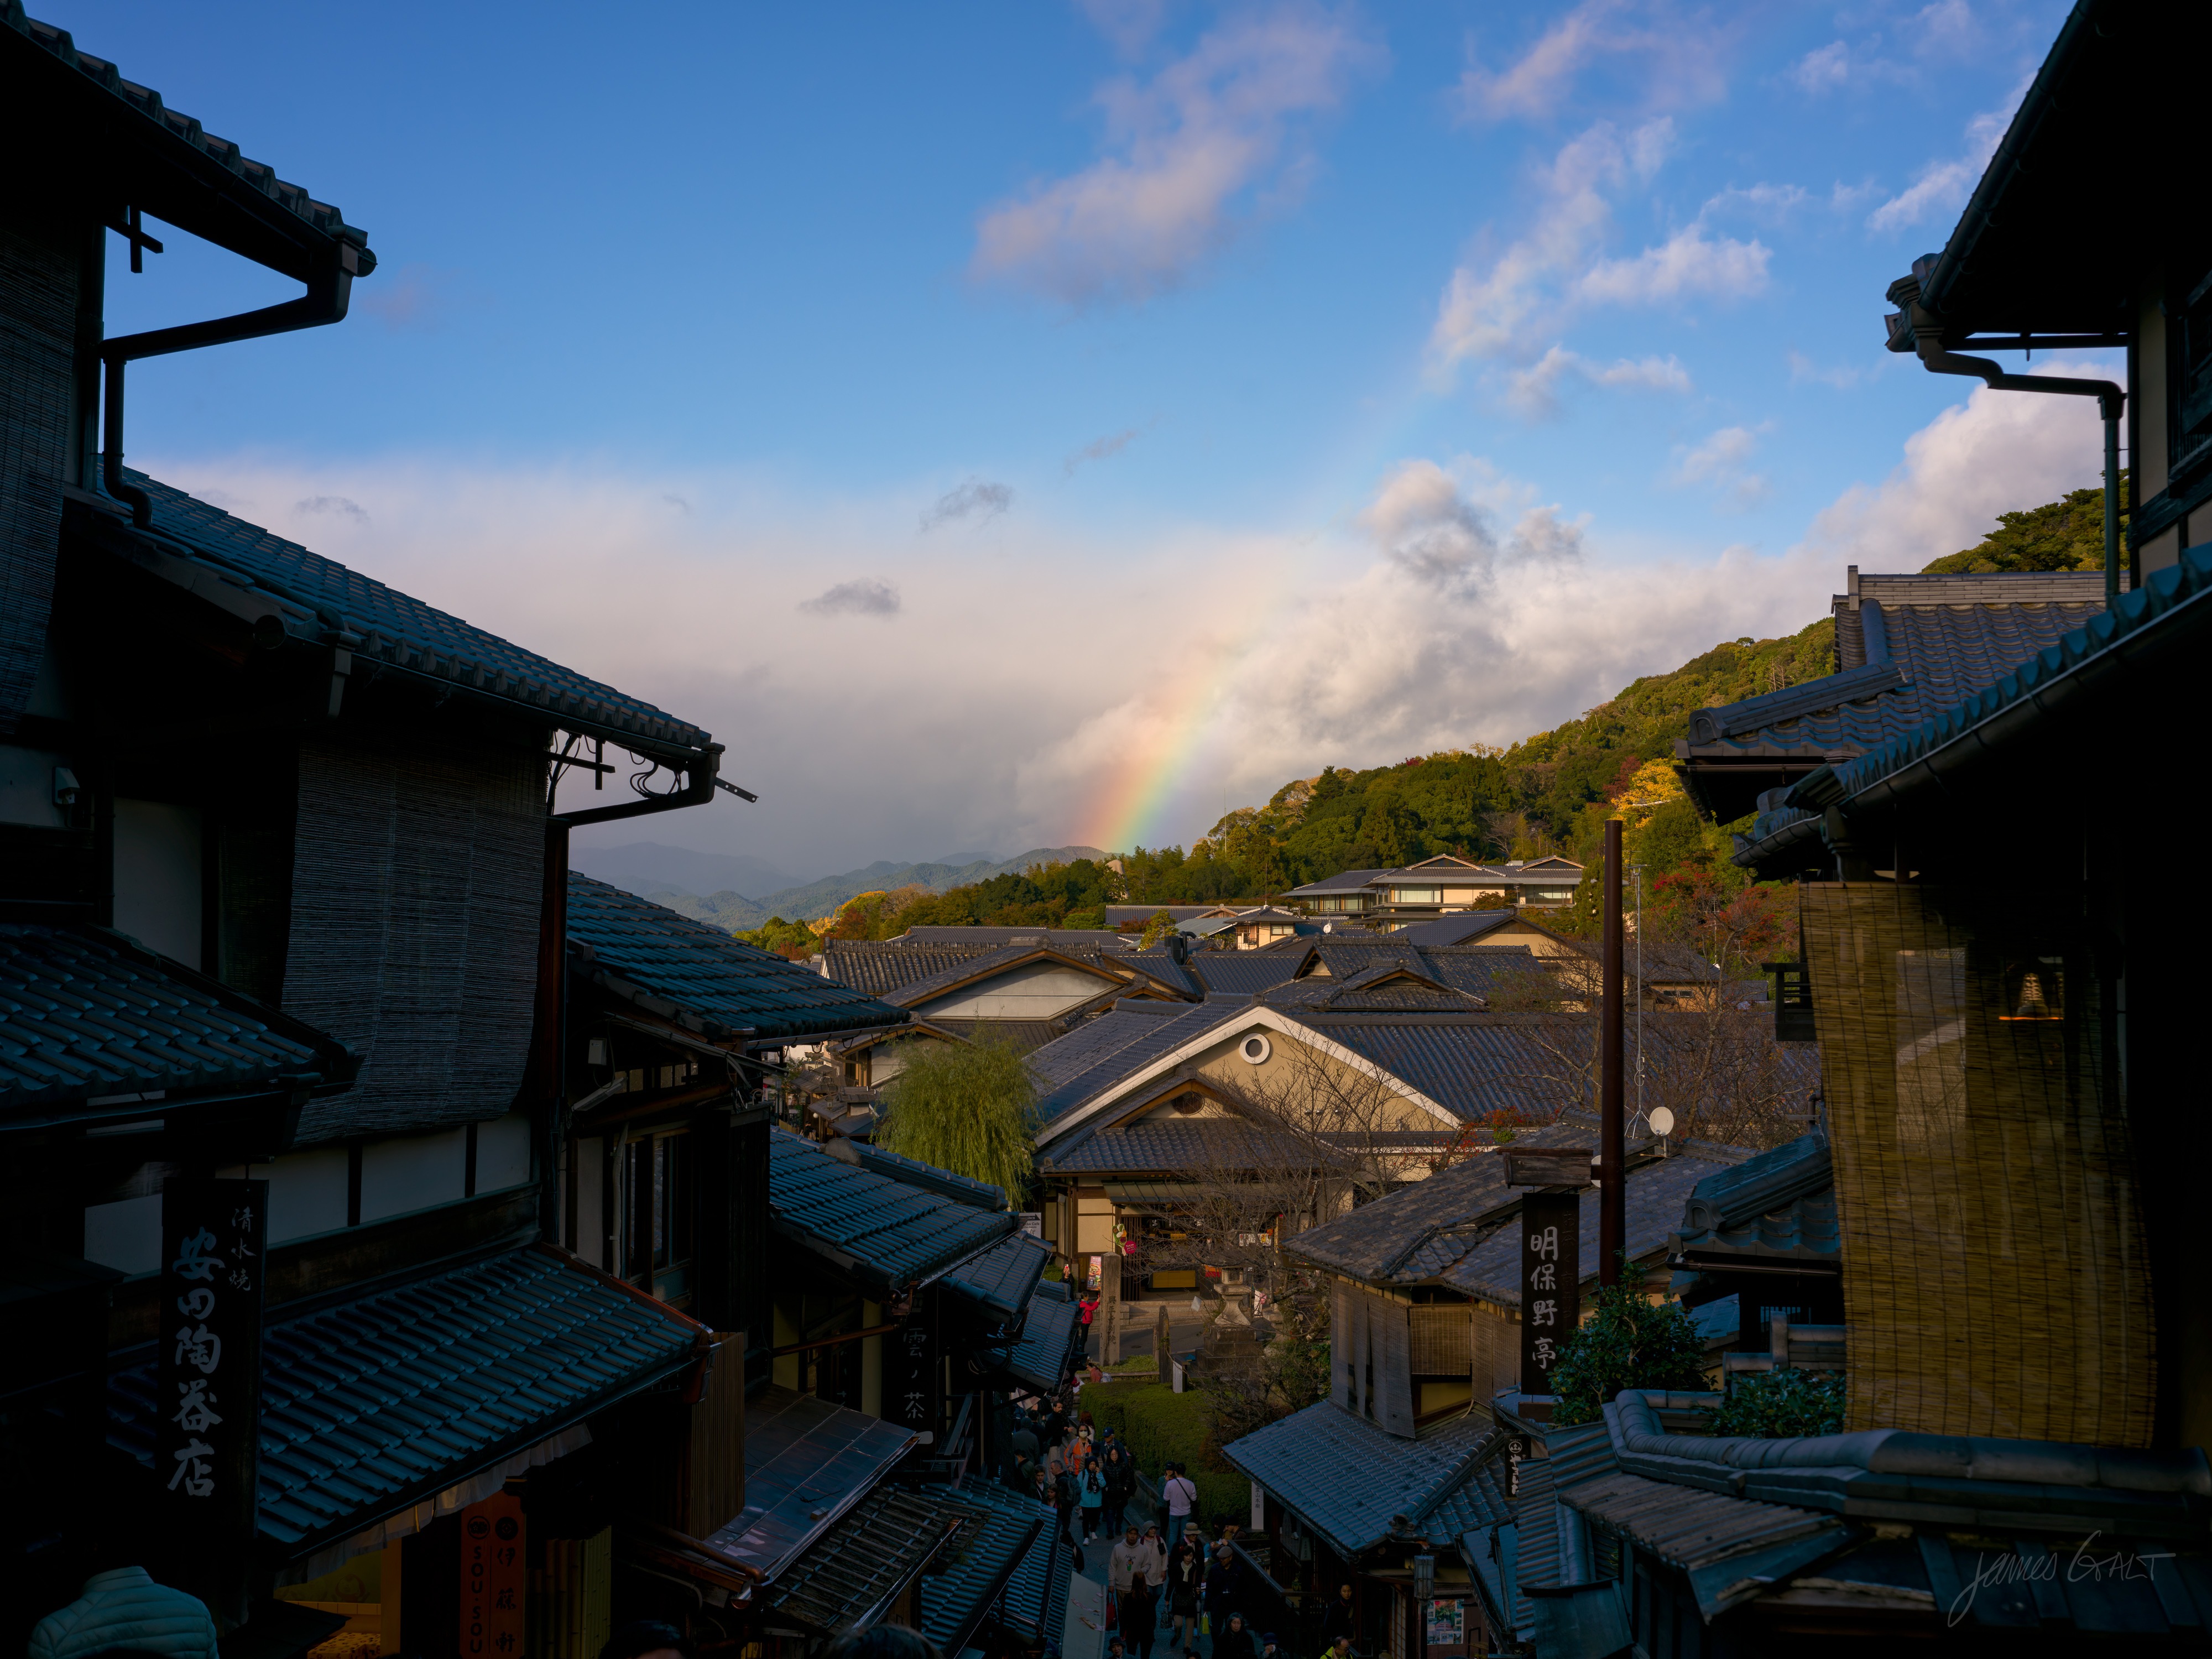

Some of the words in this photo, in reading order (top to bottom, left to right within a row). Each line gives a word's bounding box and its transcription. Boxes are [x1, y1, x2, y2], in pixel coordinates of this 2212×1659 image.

[168, 1226, 226, 1499] 安田陶器店
[1530, 1226, 1558, 1370] 明保野亭
[903, 1328, 927, 1419] 雲ノ茶
